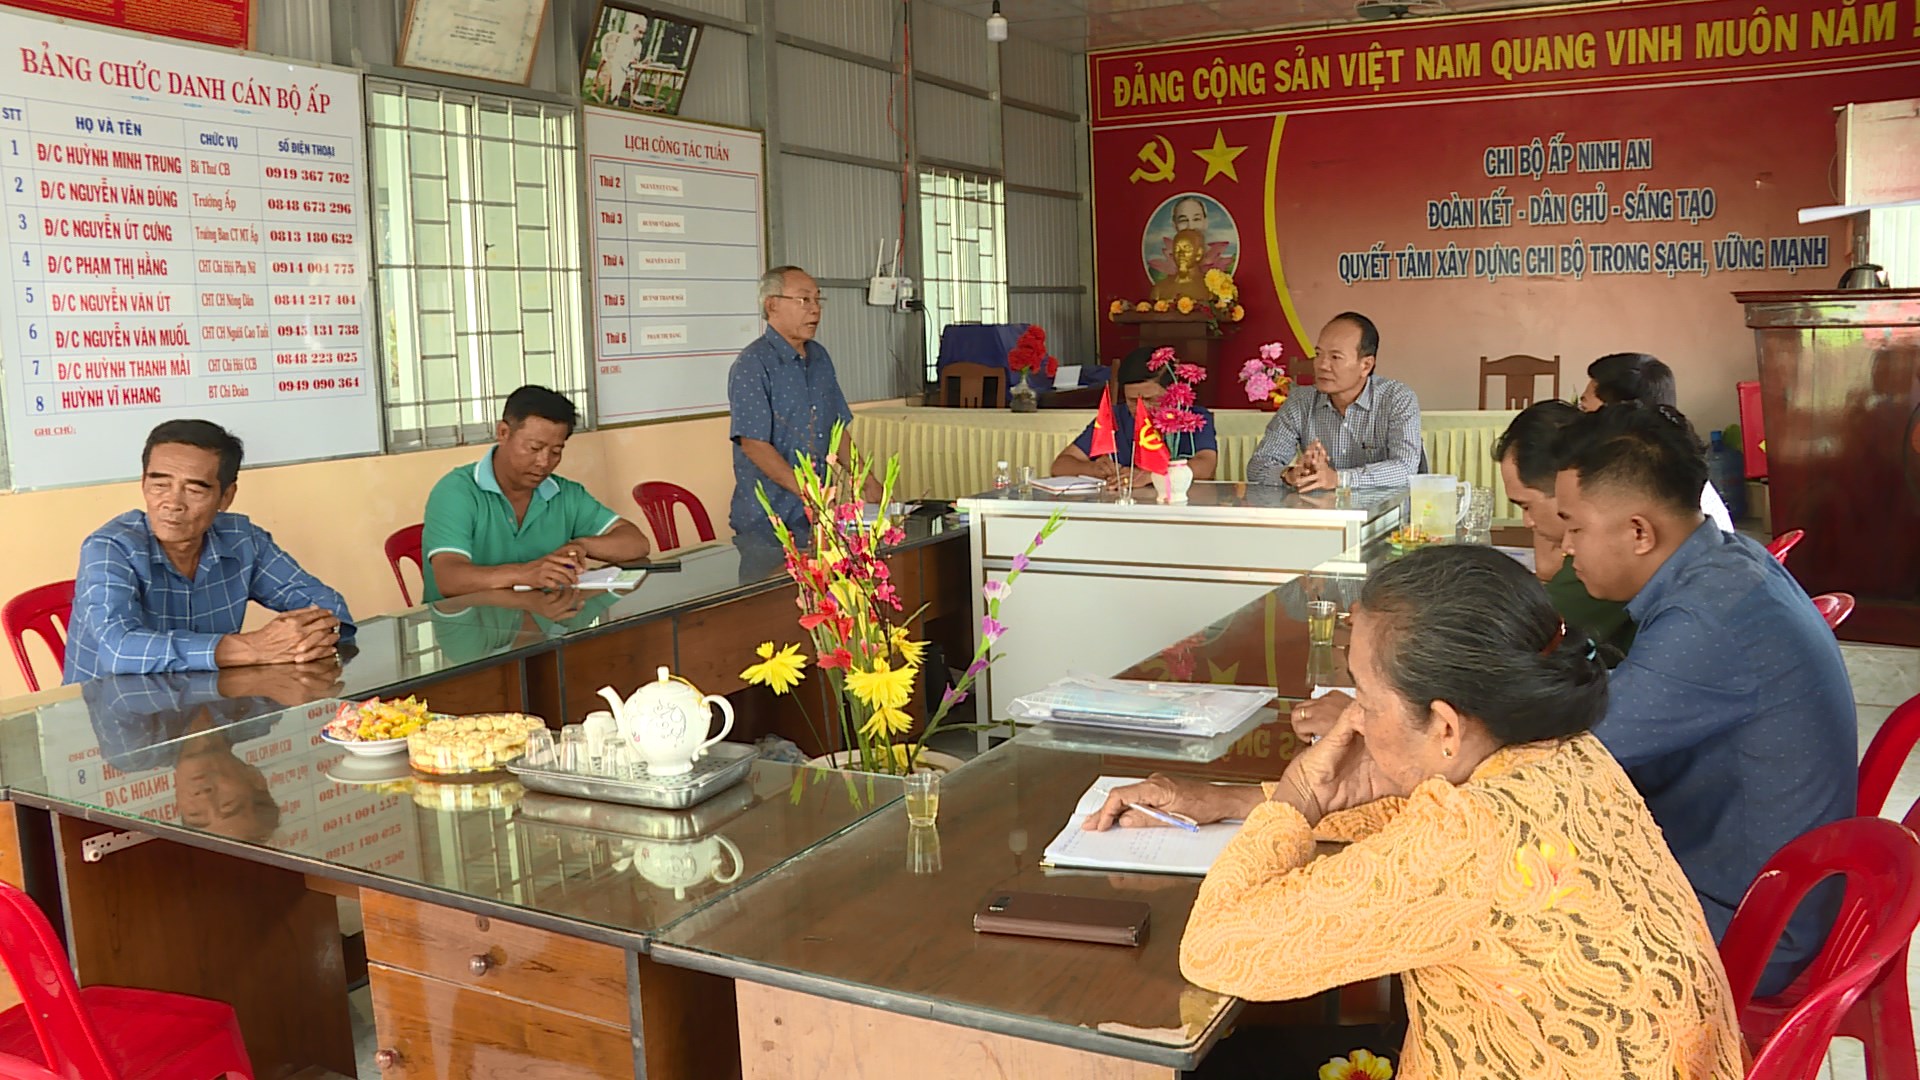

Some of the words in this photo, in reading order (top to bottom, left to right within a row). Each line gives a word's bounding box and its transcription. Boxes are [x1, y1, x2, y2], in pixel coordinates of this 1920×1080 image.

[1113, 61, 1185, 108] ĐẢNG
[1192, 56, 1266, 105] CỘNG
[1274, 44, 1330, 93] SẢN
[1338, 42, 1405, 92] VIỆT
[1416, 42, 1481, 82] NAM
[1491, 31, 1596, 80] QUANG
[1605, 25, 1682, 66] VINH
[1695, 10, 1798, 60] MUÔN
[1810, 0, 1897, 49] NĂM
[19, 41, 92, 82] BẢNG
[100, 60, 161, 92] CHỨC
[168, 72, 226, 101] DANH
[232, 78, 271, 106] CÁN
[277, 84, 301, 116] BỘ
[307, 83, 330, 114] ẤP
[2, 107, 22, 121] STT
[76, 116, 94, 133] HỌ
[98, 117, 114, 134] VÀ
[117, 119, 142, 136] TÊN
[11, 139, 19, 156] 1
[200, 131, 224, 147] CHỨC
[226, 136, 238, 150] VỤ
[278, 137, 289, 152] SỐ
[292, 140, 310, 155] ĐIỆN
[312, 144, 335, 159] THOẠI
[624, 135, 649, 153] LỊCH
[652, 135, 680, 155] CÔNG
[683, 139, 702, 158] TÁC
[705, 141, 730, 161] TUẦN
[37, 143, 63, 163] Đ/C
[66, 143, 109, 167] HUỲNH
[112, 151, 142, 170] MINH
[145, 154, 182, 174] TRUNG
[1484, 147, 1515, 177] CHI
[1518, 137, 1544, 180] BỘ
[1548, 133, 1574, 174] ẤP
[1577, 140, 1620, 172] NINH
[1625, 139, 1652, 171] AN
[218, 162, 231, 176] CB
[265, 167, 297, 180] 0919
[301, 170, 324, 182] 367
[329, 172, 350, 184] 702
[14, 176, 24, 193] 2
[600, 175, 613, 188] Thứ
[615, 177, 621, 188] 2
[40, 180, 65, 200] Đ/C
[69, 177, 118, 204] NGUYỄN
[121, 185, 145, 206] VĂN
[148, 185, 178, 208] ĐÚNG
[267, 198, 300, 211] 0848
[303, 201, 326, 213] 673
[329, 203, 352, 215] 296
[1427, 192, 1475, 229] ĐOÀN
[1478, 186, 1513, 226] KẾT
[1528, 187, 1566, 225] DÂN
[1570, 181, 1608, 223] CHỦ
[1624, 183, 1674, 221] SÁNG
[1676, 187, 1716, 225] TẠO
[18, 213, 27, 230] 3
[44, 217, 69, 237] Đ/C
[73, 213, 121, 240] NGUYỄN
[124, 218, 139, 240] ÚT
[601, 212, 616, 224] Thứ
[617, 213, 623, 224] 3
[270, 230, 301, 243] 0813
[306, 231, 328, 243] 180
[331, 232, 353, 244] 632
[22, 251, 30, 266] 4
[48, 255, 72, 274] Đ/C
[76, 257, 110, 278] PHẠM
[114, 258, 134, 279] THỊ
[603, 254, 617, 266] Thứ
[618, 255, 624, 266] 4
[1338, 241, 1392, 286] QUYẾT
[1395, 244, 1432, 280] TÂM
[1435, 241, 1471, 277] XÂY
[1474, 242, 1521, 283] DỰNG
[1525, 246, 1555, 276] CHI
[1560, 237, 1585, 281] BỘ
[1588, 243, 1650, 274] TRONG
[1654, 240, 1709, 278] SẠCH,
[1713, 232, 1765, 270] VỮNG
[1769, 236, 1828, 275] MẠNH
[272, 262, 303, 274] 0914
[334, 263, 354, 275] 775
[26, 287, 34, 303] 5
[52, 294, 76, 312] Đ/C
[80, 287, 128, 312] NGUYỄN
[130, 292, 154, 312] VĂN
[157, 291, 171, 312] ÚT
[309, 294, 330, 305] 217
[604, 294, 618, 306] Thứ
[619, 295, 625, 306] 5
[29, 323, 37, 340] 6
[56, 330, 80, 348] Đ/C
[83, 322, 130, 348] NGUYỄN
[133, 326, 157, 347] VĂN
[160, 322, 190, 346] MUỐL
[314, 325, 333, 336] 131
[338, 325, 359, 336] 738
[606, 332, 620, 344] Thứ
[621, 333, 627, 343] 6
[276, 353, 307, 365] 0848
[311, 353, 333, 364] 223
[336, 352, 358, 363] 025
[33, 360, 40, 376] 7
[58, 360, 82, 380] Đ/C
[85, 357, 126, 379] HUỲNH
[129, 359, 167, 378] THANH
[278, 380, 309, 392] 0949
[313, 379, 335, 390] 090
[338, 377, 359, 388] 364
[36, 396, 44, 412] 8
[62, 386, 103, 409] HUỲNH
[107, 385, 119, 406] VĨ
[123, 386, 161, 404] KHANG
